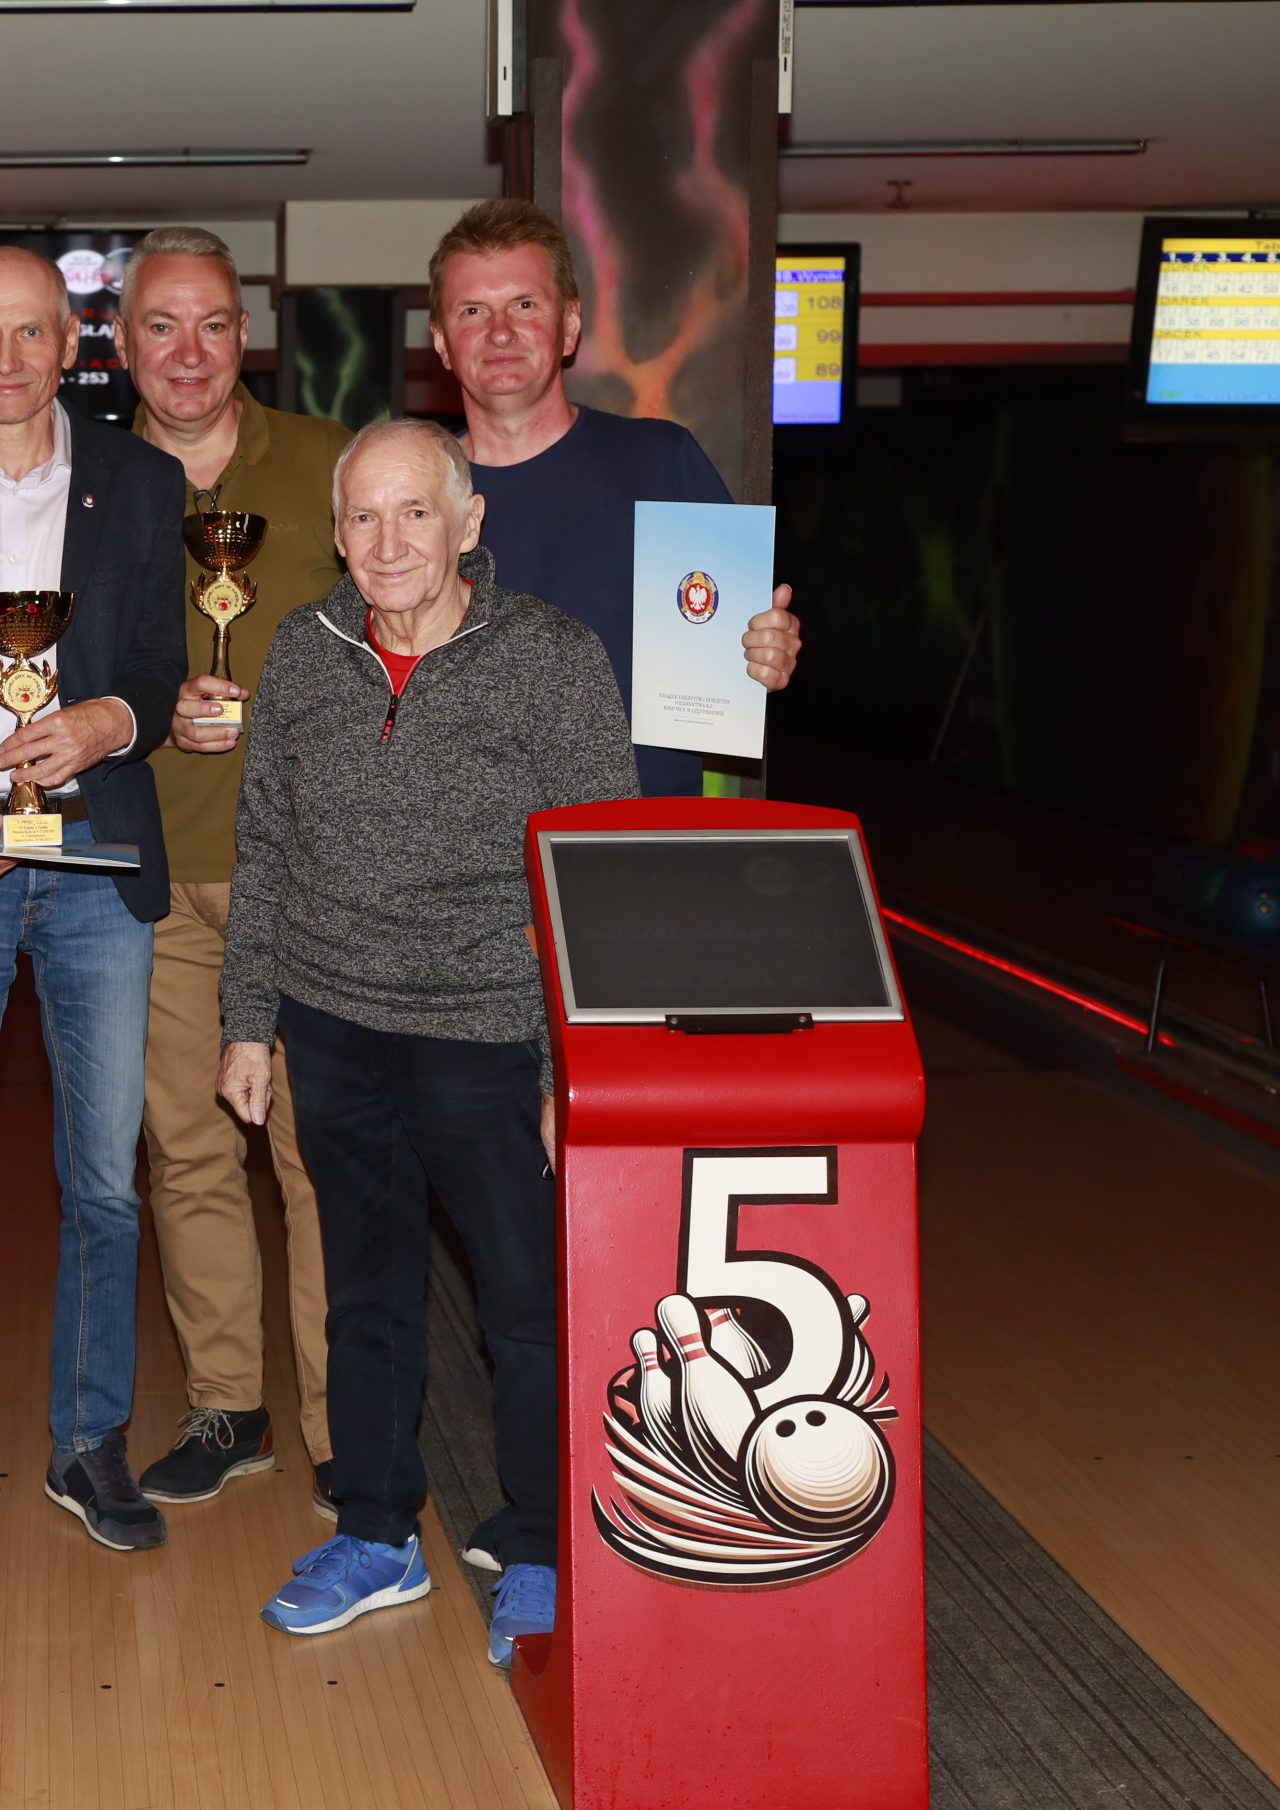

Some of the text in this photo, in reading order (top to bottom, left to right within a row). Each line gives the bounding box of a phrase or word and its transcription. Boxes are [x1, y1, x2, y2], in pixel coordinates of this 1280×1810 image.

[1191, 252, 1207, 263] 2.
[1217, 252, 1231, 263] 3.
[1241, 252, 1256, 263] 4.
[677, 1146, 838, 1406] 5
